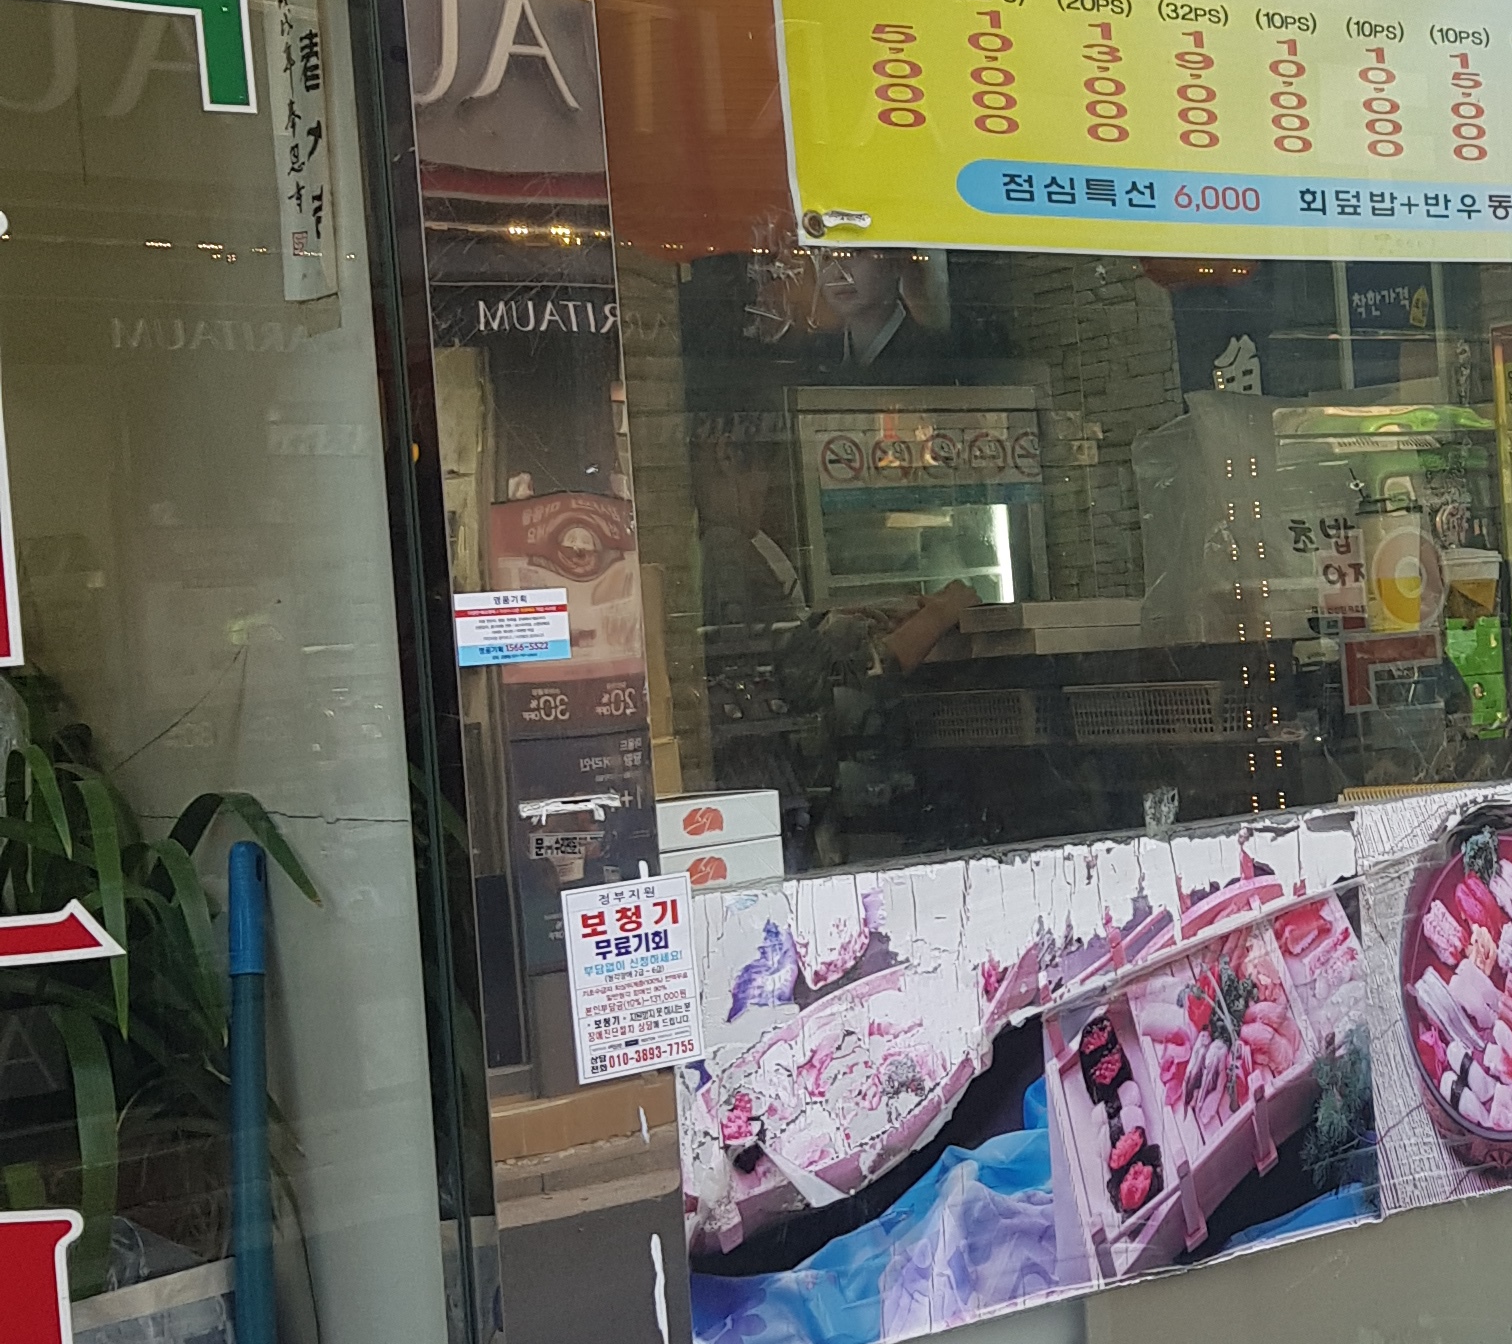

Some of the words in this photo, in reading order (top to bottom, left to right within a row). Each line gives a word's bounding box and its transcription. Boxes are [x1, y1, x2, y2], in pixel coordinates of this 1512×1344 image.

[1157, 0, 1229, 27] (32PS)
[1254, 8, 1318, 35] (10PS)
[1345, 16, 1405, 43] (10PS)
[1428, 24, 1491, 48] (10PS)
[1002, 172, 1157, 209] 점심특선
[1173, 184, 1261, 213] 6,000
[598, 885, 655, 906] 정부지원
[580, 898, 680, 939] 보청기
[594, 928, 670, 961] 무료기회
